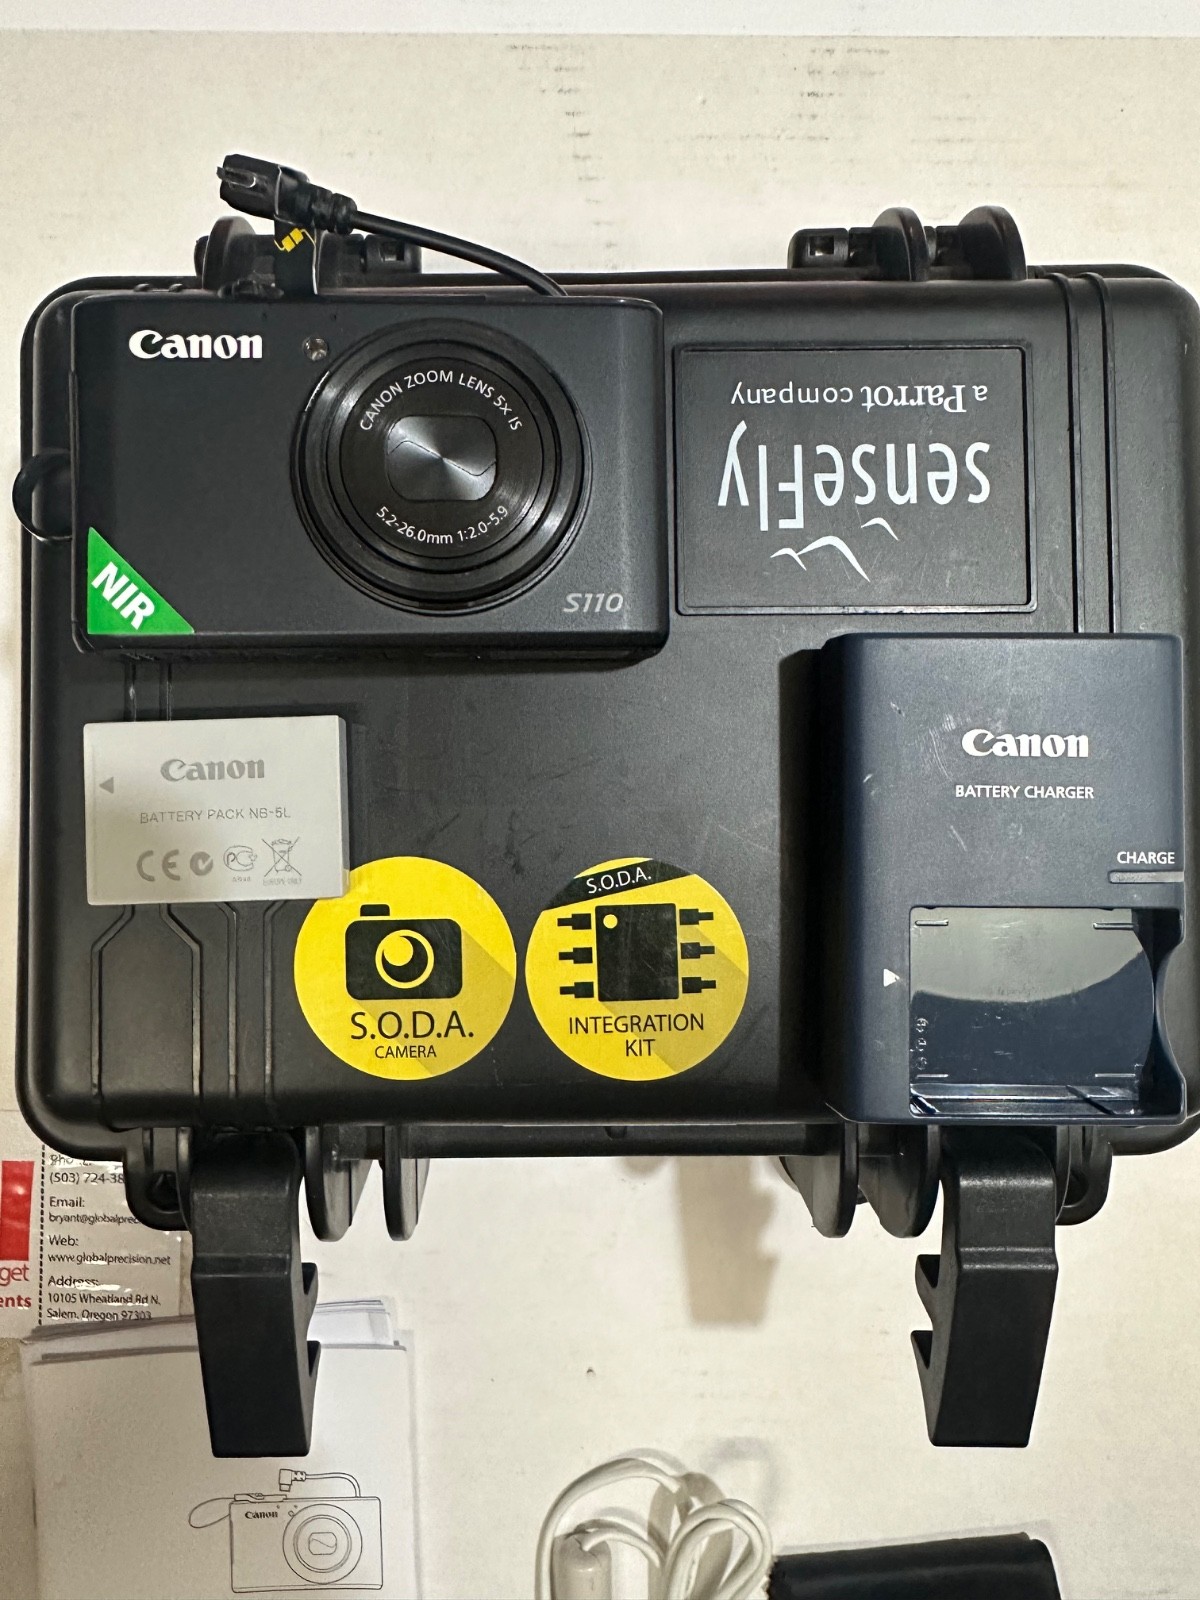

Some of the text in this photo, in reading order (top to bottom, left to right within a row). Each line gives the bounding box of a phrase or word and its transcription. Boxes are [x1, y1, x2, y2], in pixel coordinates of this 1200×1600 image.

[128, 329, 263, 360] Canon
[360, 382, 403, 431] CANON
[404, 370, 453, 390] ZOOM
[458, 373, 495, 398] LENS
[508, 416, 523, 431] IS
[731, 381, 988, 413] a Parrot company
[376, 505, 508, 544] 5.2-26.0mm 1:2.0-5.9
[91, 561, 155, 630] NIR
[563, 592, 624, 613] S110
[962, 728, 1089, 758] Canon
[160, 758, 265, 782] Canon
[955, 785, 1095, 800] BATTERY CHARGER
[140, 809, 203, 825] BATTERY
[207, 807, 244, 820] PACK
[1117, 851, 1175, 865] CHARGE
[586, 866, 652, 894] S.O.D.A.
[351, 1010, 474, 1040] S.O.D.A.
[569, 1013, 704, 1035] INTEGRATION
[374, 1044, 437, 1059] CAMERA
[625, 1038, 656, 1057] KIT
[49, 1172, 80, 1185] (503)
[49, 1196, 85, 1208] Email:
[49, 1235, 79, 1246] Web:
[48, 1293, 77, 1304] 10105
[79, 1293, 133, 1304] Wheatland
[82, 1309, 118, 1322] Oregon
[245, 1511, 279, 1519] Canon
